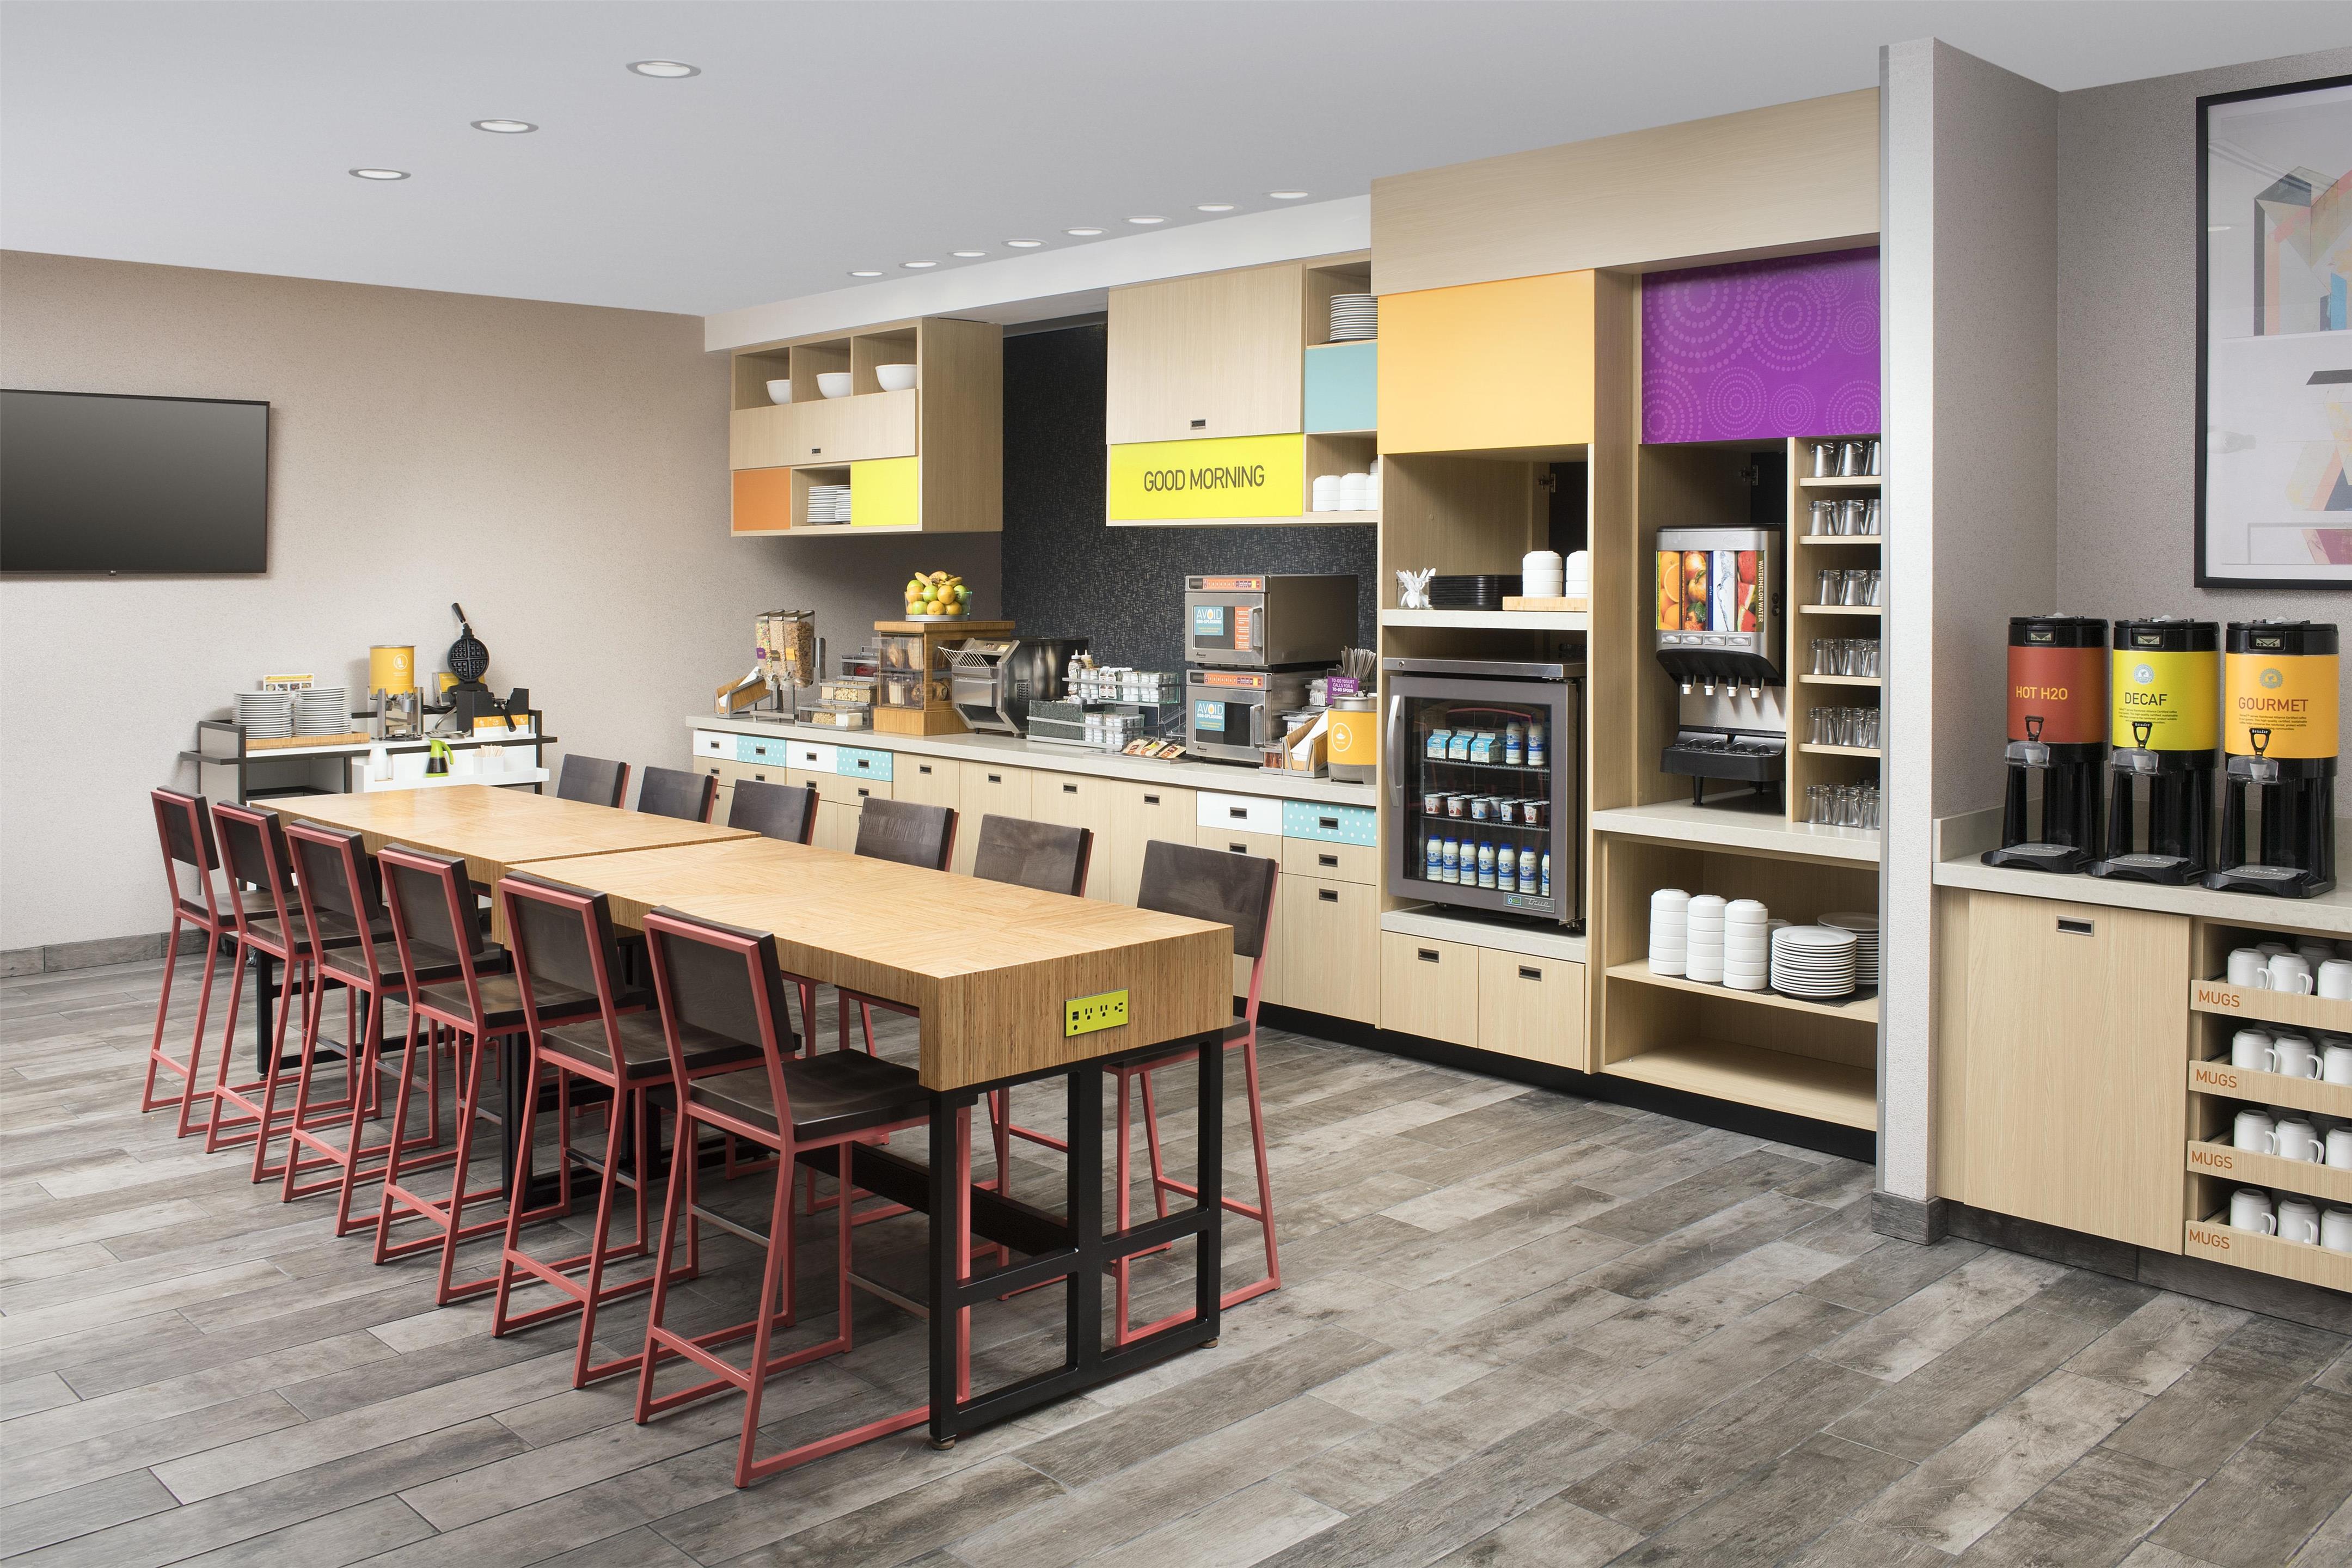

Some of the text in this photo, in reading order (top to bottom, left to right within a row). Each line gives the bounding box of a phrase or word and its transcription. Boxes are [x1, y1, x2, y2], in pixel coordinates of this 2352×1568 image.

[1144, 464, 1265, 492] GOOD MORNING
[1196, 609, 1222, 620] AVOID
[2016, 686, 2068, 700] HOT H2O
[2125, 692, 2168, 706] DECAF
[1197, 703, 1223, 715] AVOID
[2239, 697, 2308, 712] GOURMET
[2199, 989, 2240, 1007] MUGS
[2196, 1069, 2237, 1088] MUGS
[2191, 1150, 2232, 1169] MUGS
[2189, 1229, 2230, 1250] MUGS
